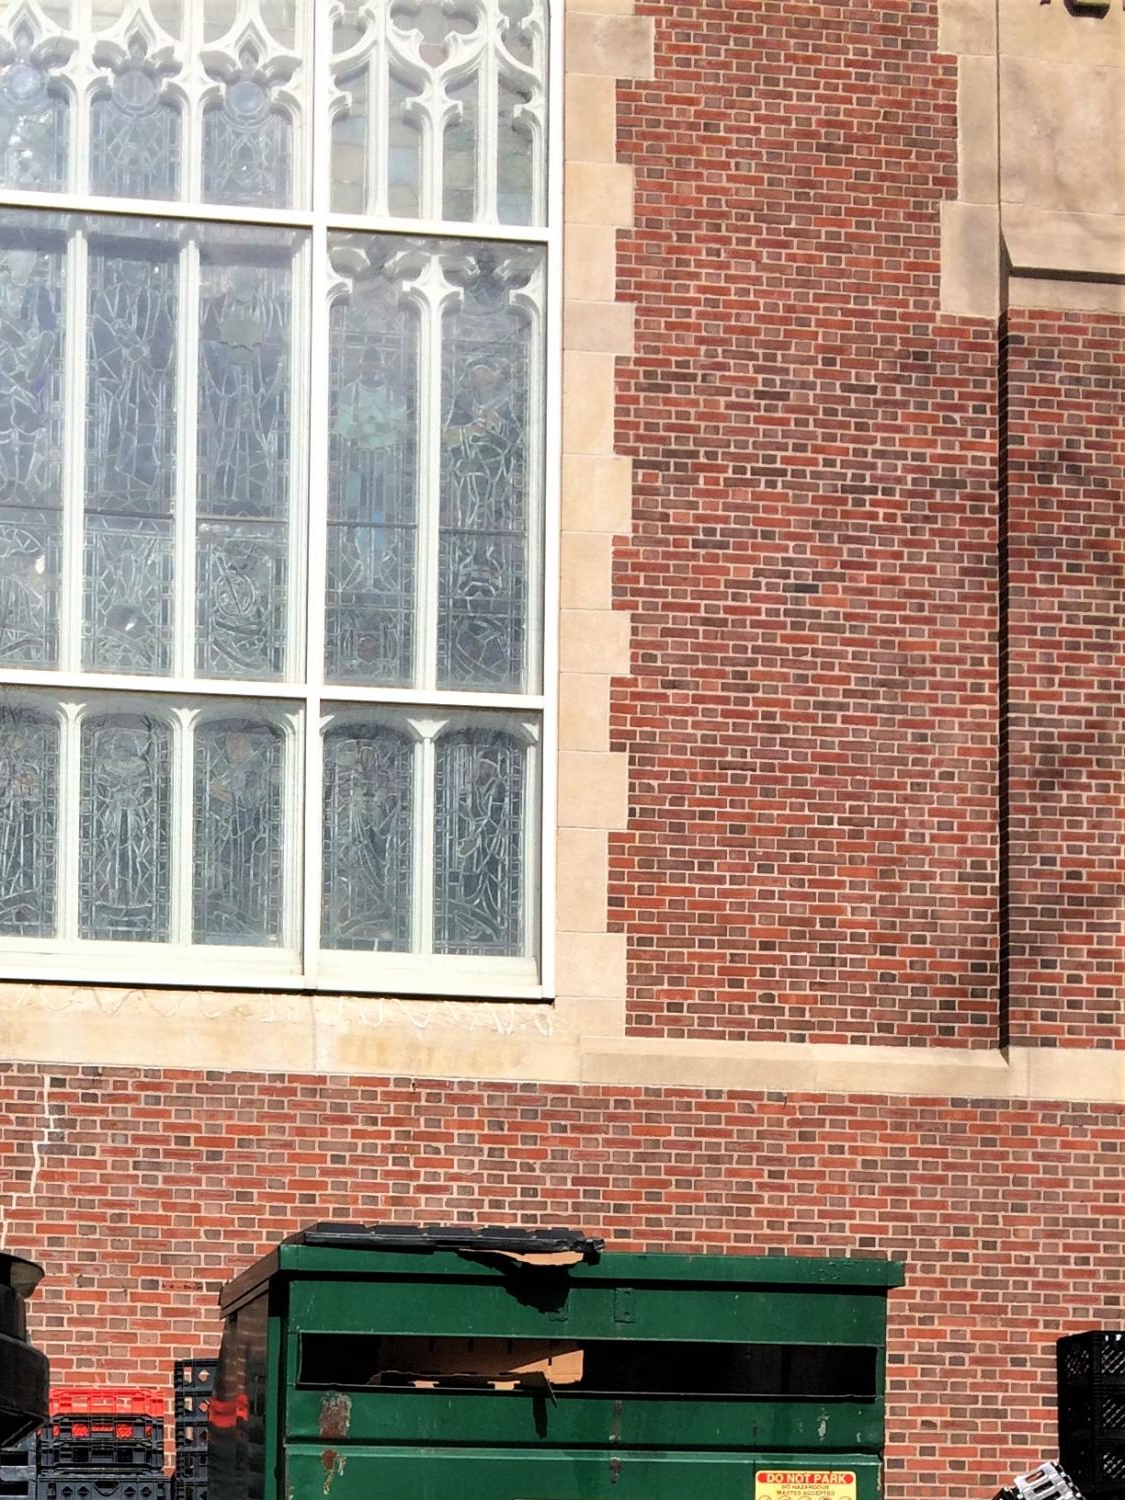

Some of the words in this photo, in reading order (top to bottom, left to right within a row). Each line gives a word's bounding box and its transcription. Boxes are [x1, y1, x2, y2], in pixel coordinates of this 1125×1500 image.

[767, 1474, 784, 1483] DO
[787, 1474, 811, 1484] NOT
[814, 1474, 846, 1484] PARK
